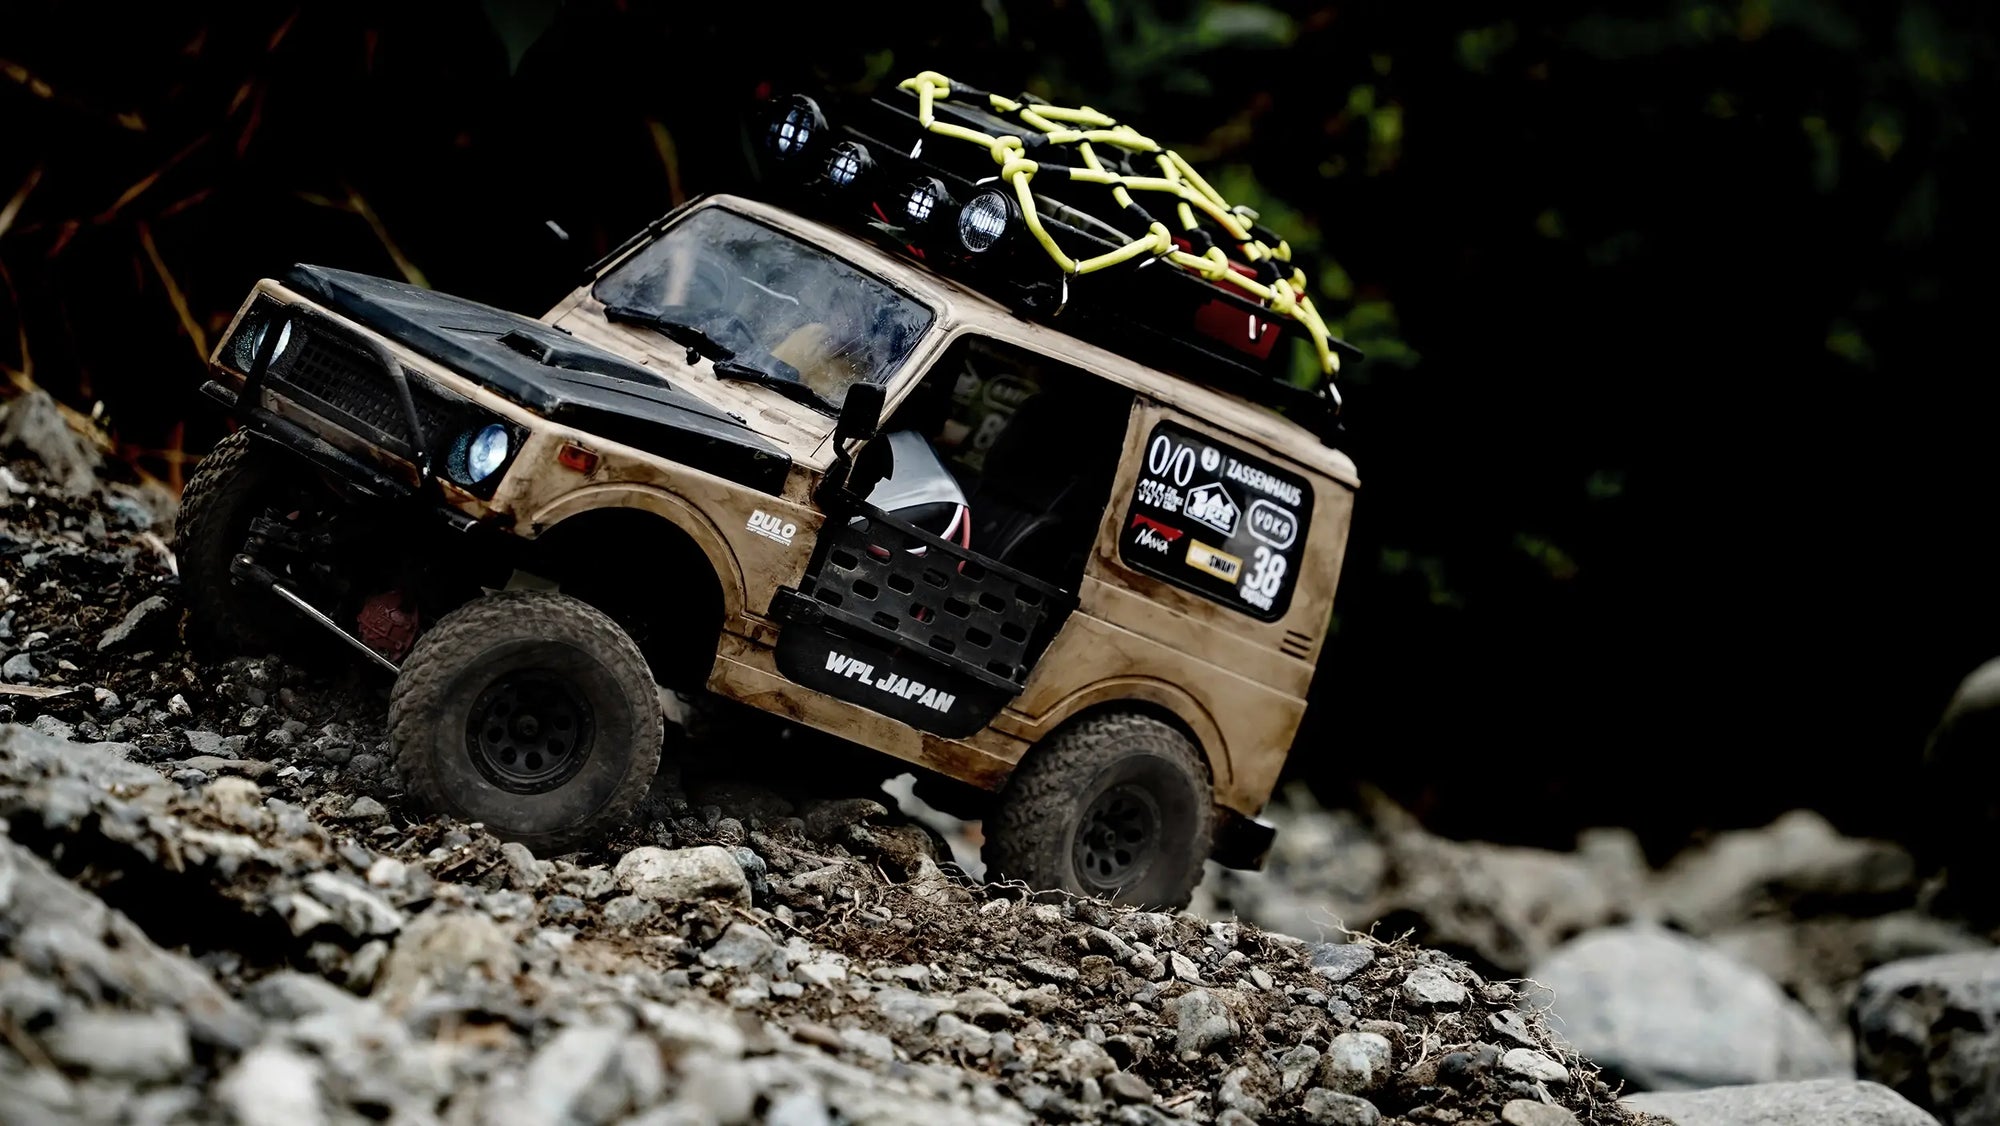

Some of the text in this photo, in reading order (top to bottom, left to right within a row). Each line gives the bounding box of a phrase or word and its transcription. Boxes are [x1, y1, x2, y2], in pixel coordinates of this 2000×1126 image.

[1227, 459, 1302, 507] ZASSENHAUS
[748, 510, 797, 539] DULO
[1255, 509, 1290, 539] YOKA
[1245, 546, 1287, 598] 38
[825, 651, 956, 714] WPL JAPAN
